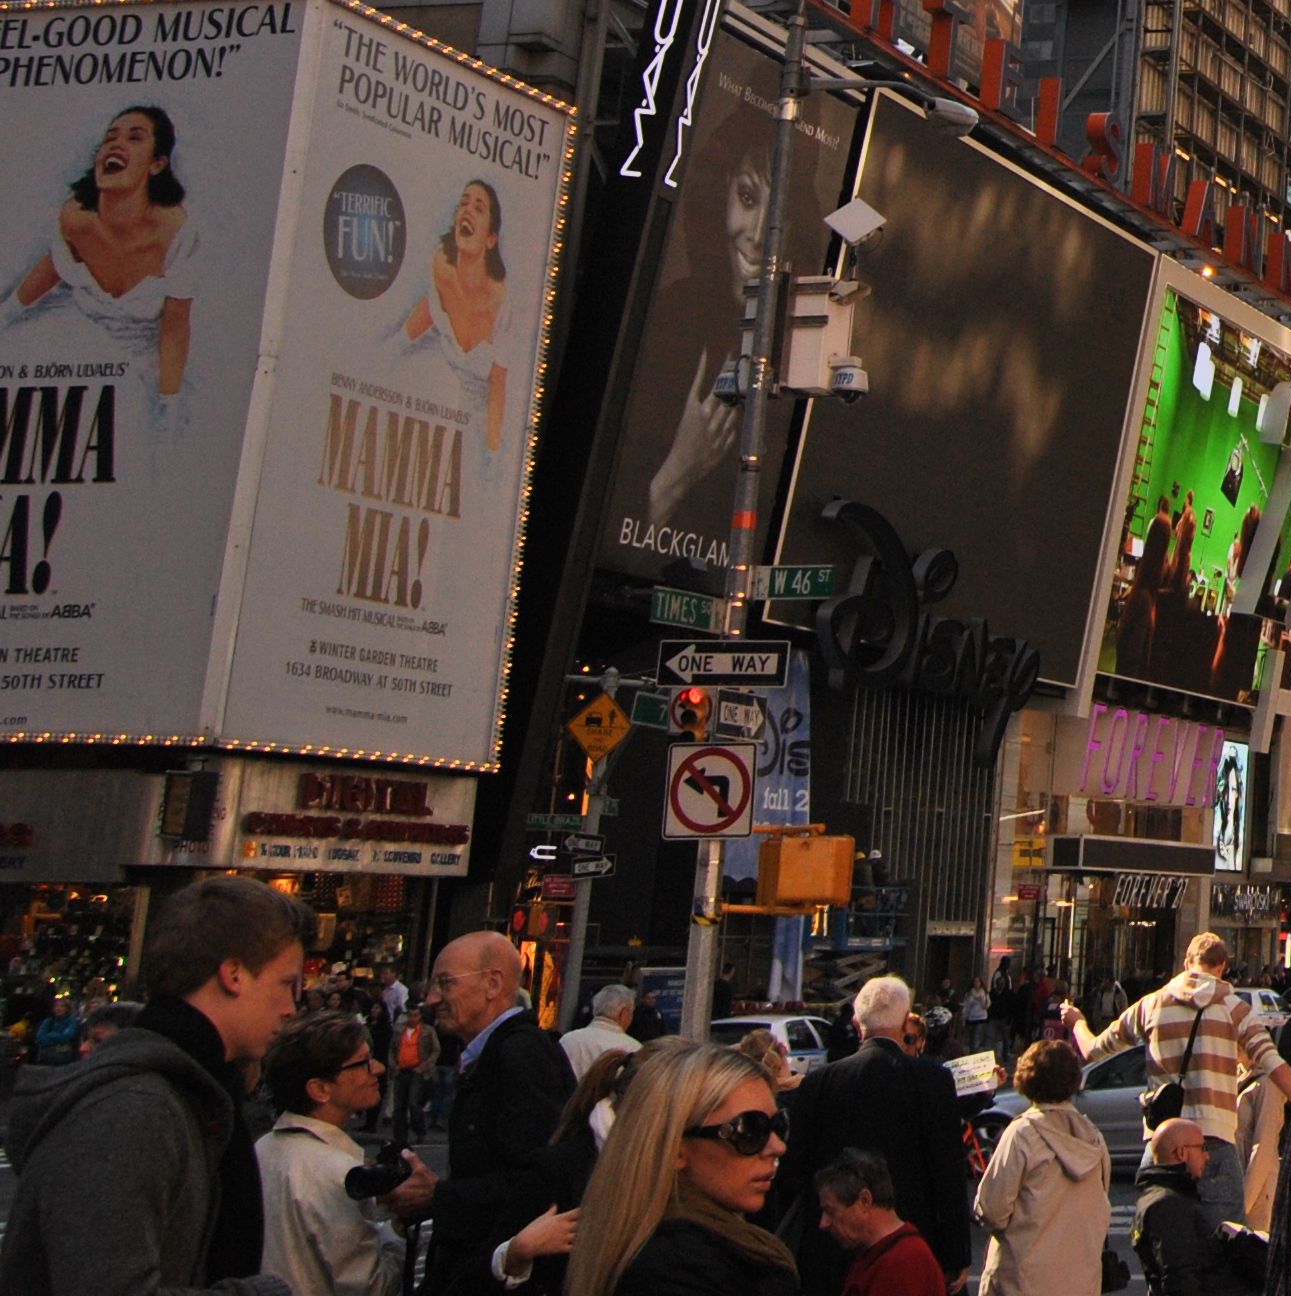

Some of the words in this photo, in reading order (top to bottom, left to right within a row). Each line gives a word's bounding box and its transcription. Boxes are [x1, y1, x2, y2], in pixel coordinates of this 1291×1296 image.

[0, 14, 143, 50] EL-GOOD
[156, 3, 297, 42] MUSICAL
[338, 64, 443, 138] POPULAR
[492, 100, 550, 147] MOST
[33, 361, 76, 379] BJÖRN
[331, 371, 357, 392] BENNY
[316, 392, 464, 519] MAMMA
[335, 502, 431, 611] MIA!
[775, 569, 788, 595] W
[791, 569, 812, 595] 46
[818, 568, 832, 583] ST
[301, 596, 318, 614] THE
[318, 600, 346, 619] SMASH
[347, 605, 361, 622] HIT
[363, 610, 398, 629] MUSICAL
[657, 592, 698, 625] TIMES
[14, 647, 80, 664] THEATRE
[319, 640, 357, 661] WINTER
[359, 649, 396, 667] GARDEN
[400, 653, 439, 674] THEATRE
[678, 655, 714, 673] ONE
[732, 654, 771, 674] WAY
[47, 672, 105, 690] STREET
[284, 660, 312, 677] 1634
[314, 664, 375, 688] BROADWAY
[376, 674, 388, 689] AT
[390, 677, 417, 694] 50TH
[419, 681, 454, 698] STREET
[724, 704, 739, 723] ONE
[744, 707, 761, 724] WAY
[1079, 702, 1226, 809] FOREVER
[763, 787, 790, 811] fall
[1112, 875, 1175, 908] FOREVER
